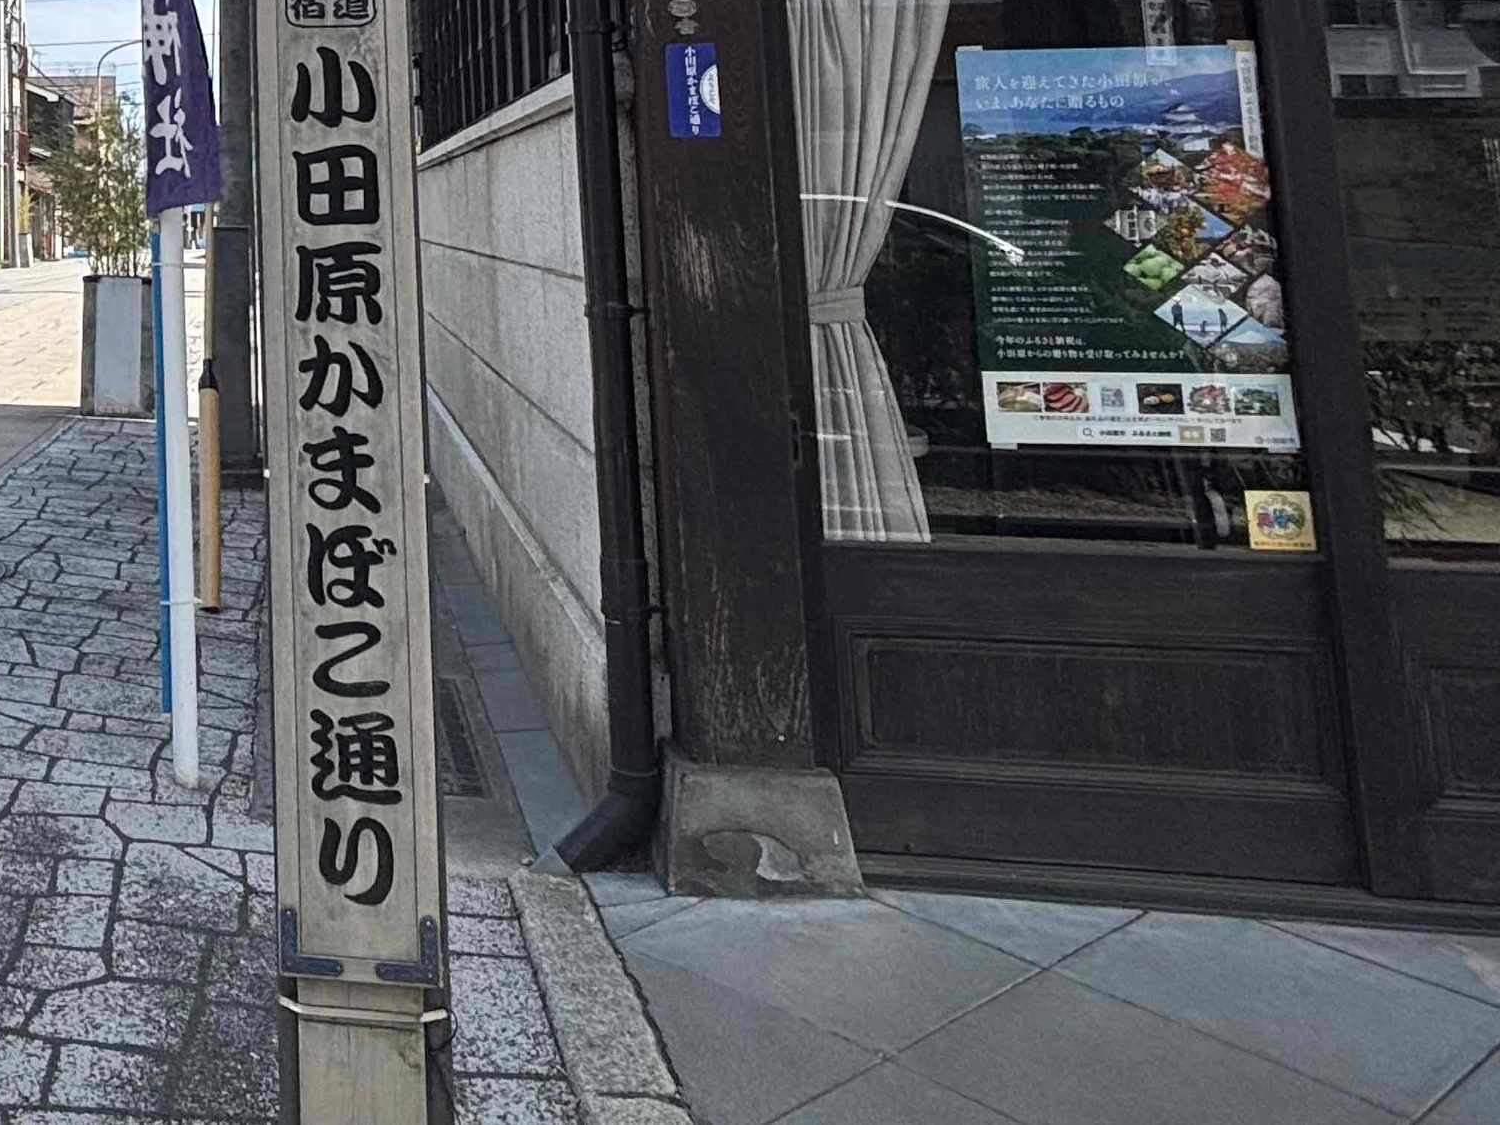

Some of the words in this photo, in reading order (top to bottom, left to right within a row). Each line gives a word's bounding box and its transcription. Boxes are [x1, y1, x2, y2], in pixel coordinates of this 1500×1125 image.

[291, 46, 403, 906] 小田原かまぼこ通り
